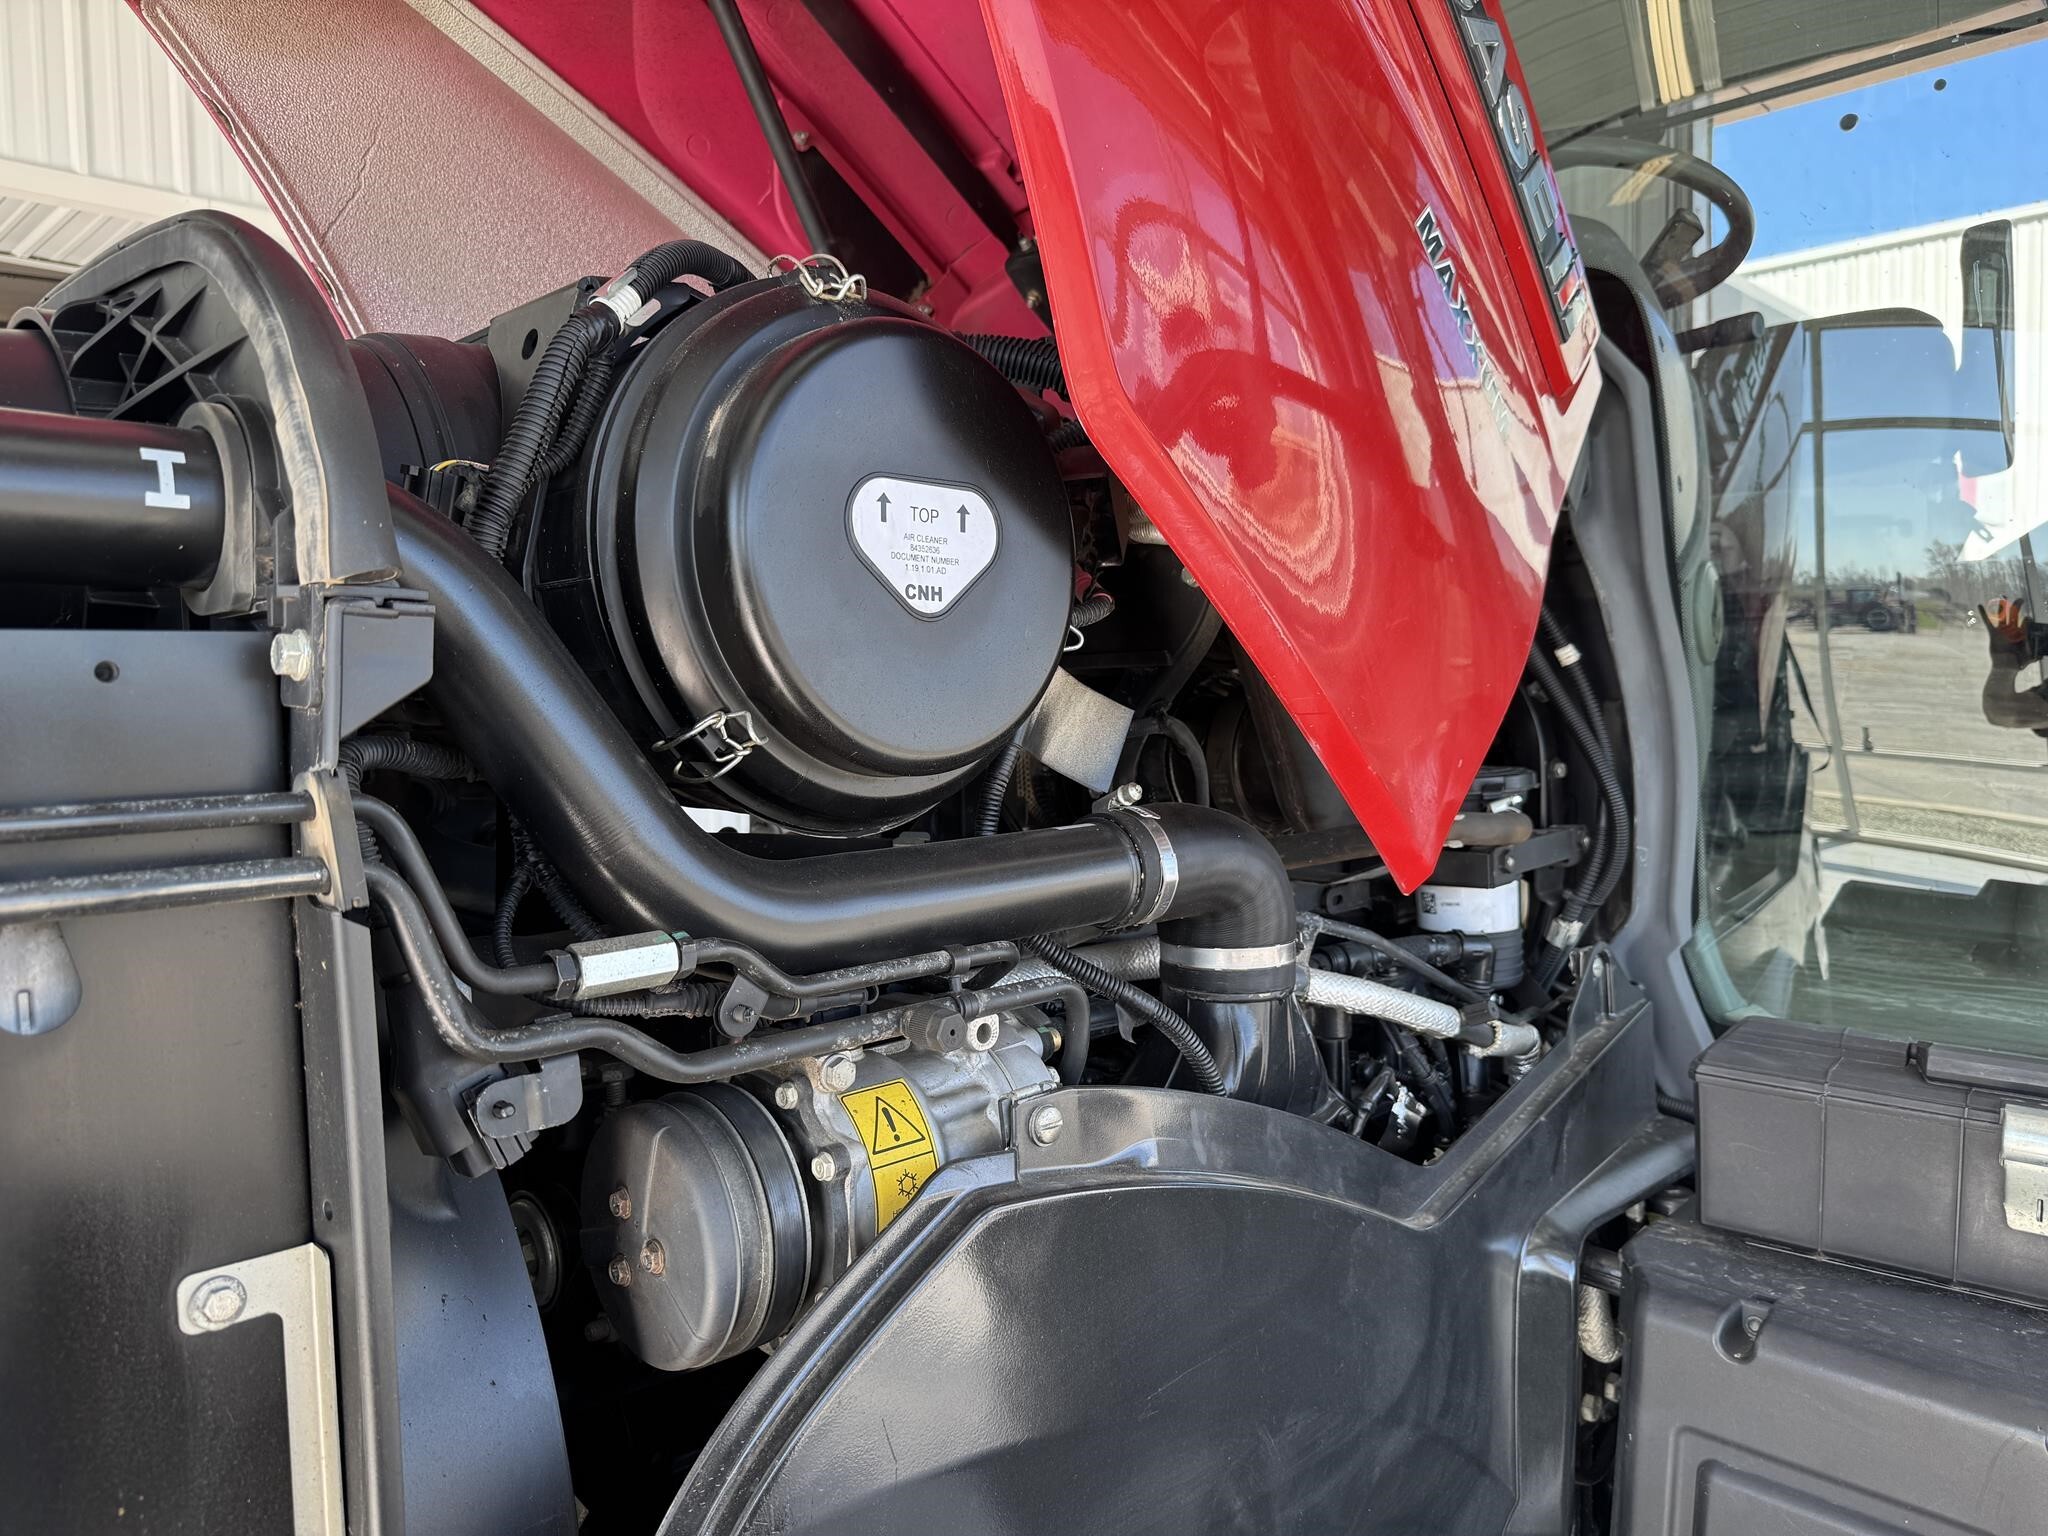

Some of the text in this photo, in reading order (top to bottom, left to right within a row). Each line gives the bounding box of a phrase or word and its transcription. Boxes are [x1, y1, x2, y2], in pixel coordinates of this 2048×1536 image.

[910, 505, 939, 523] TOP
[903, 533, 948, 545] AIR CLEANER
[890, 551, 960, 566] DOCUMENT NUMBER
[904, 583, 943, 602] CNH
